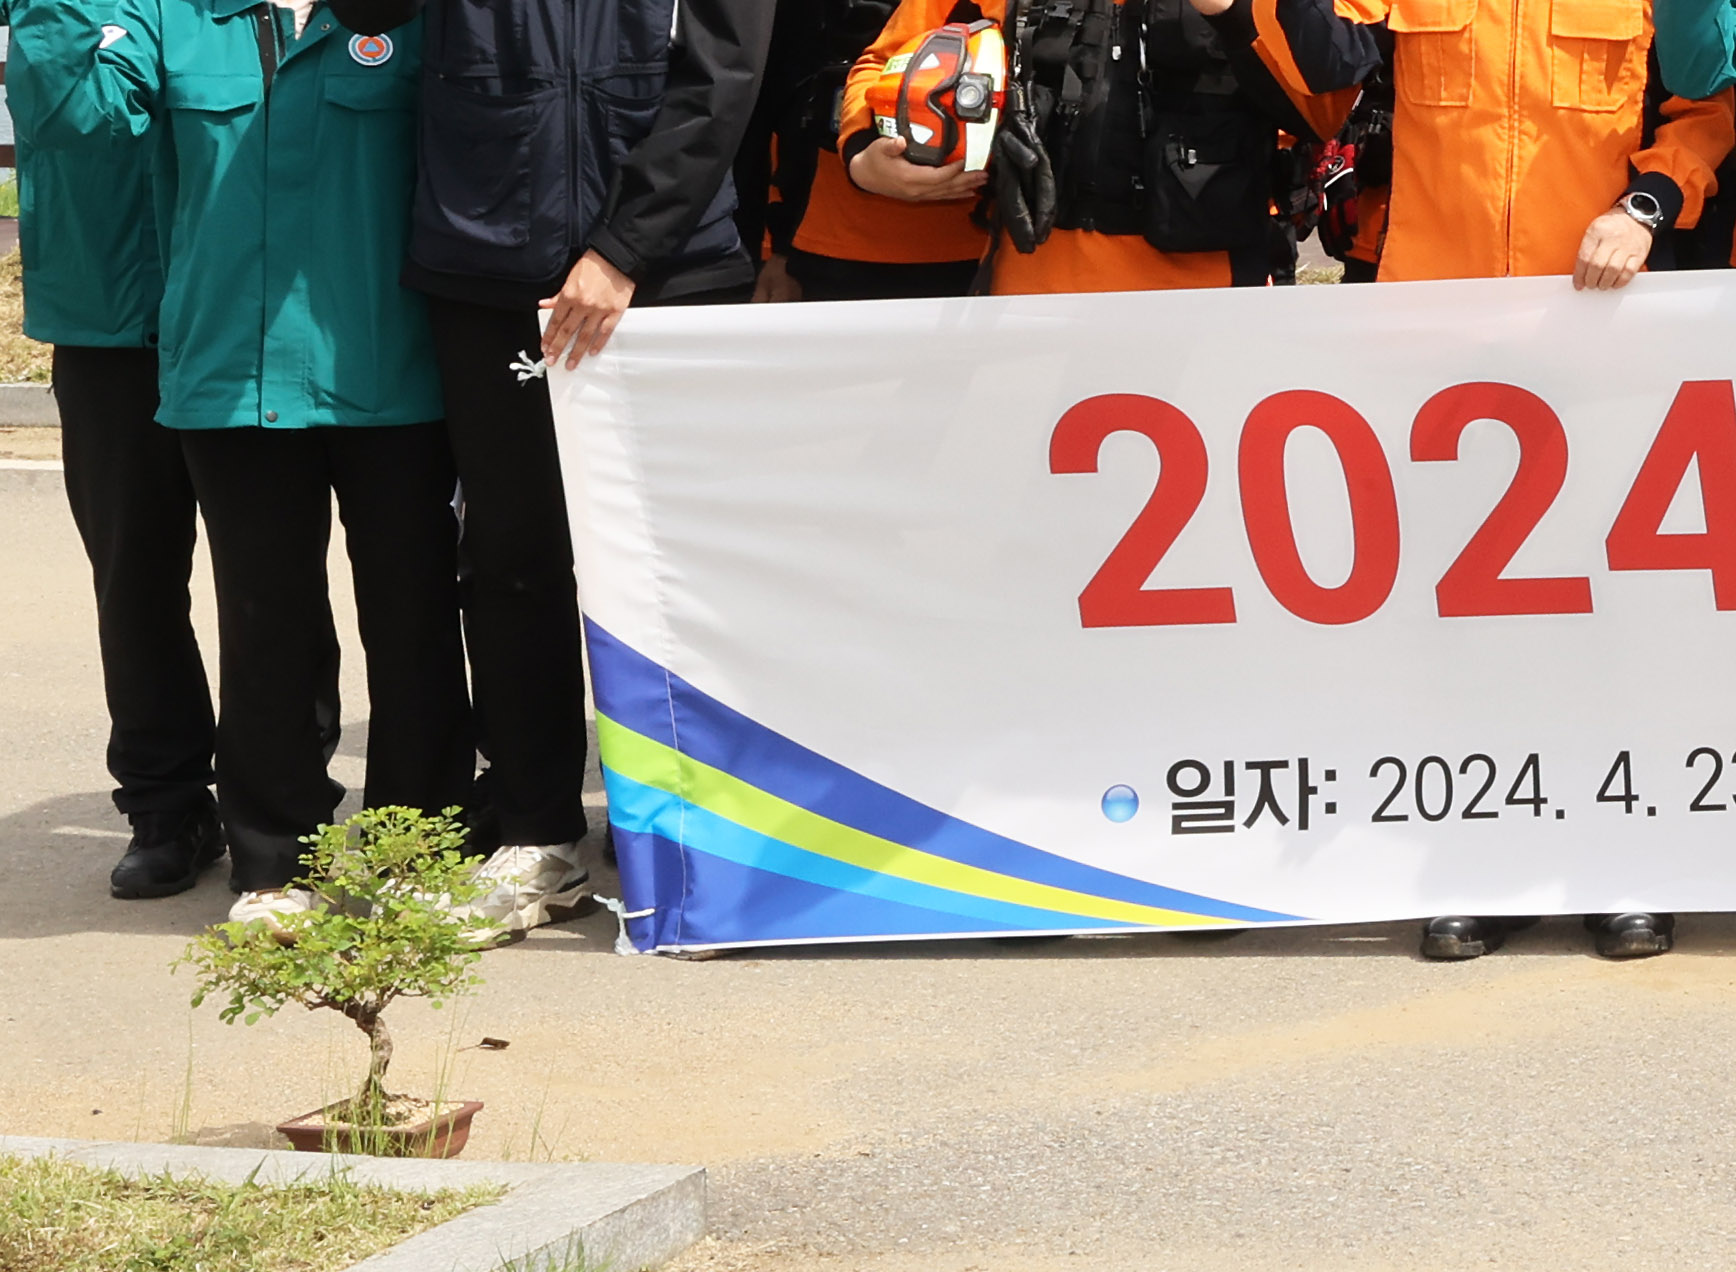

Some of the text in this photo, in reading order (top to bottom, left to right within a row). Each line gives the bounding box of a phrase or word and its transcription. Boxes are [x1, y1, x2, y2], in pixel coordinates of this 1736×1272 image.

[1165, 758, 1337, 835] 일자:
[1369, 753, 1565, 823] 2024.
[1596, 750, 1657, 817] 4.
